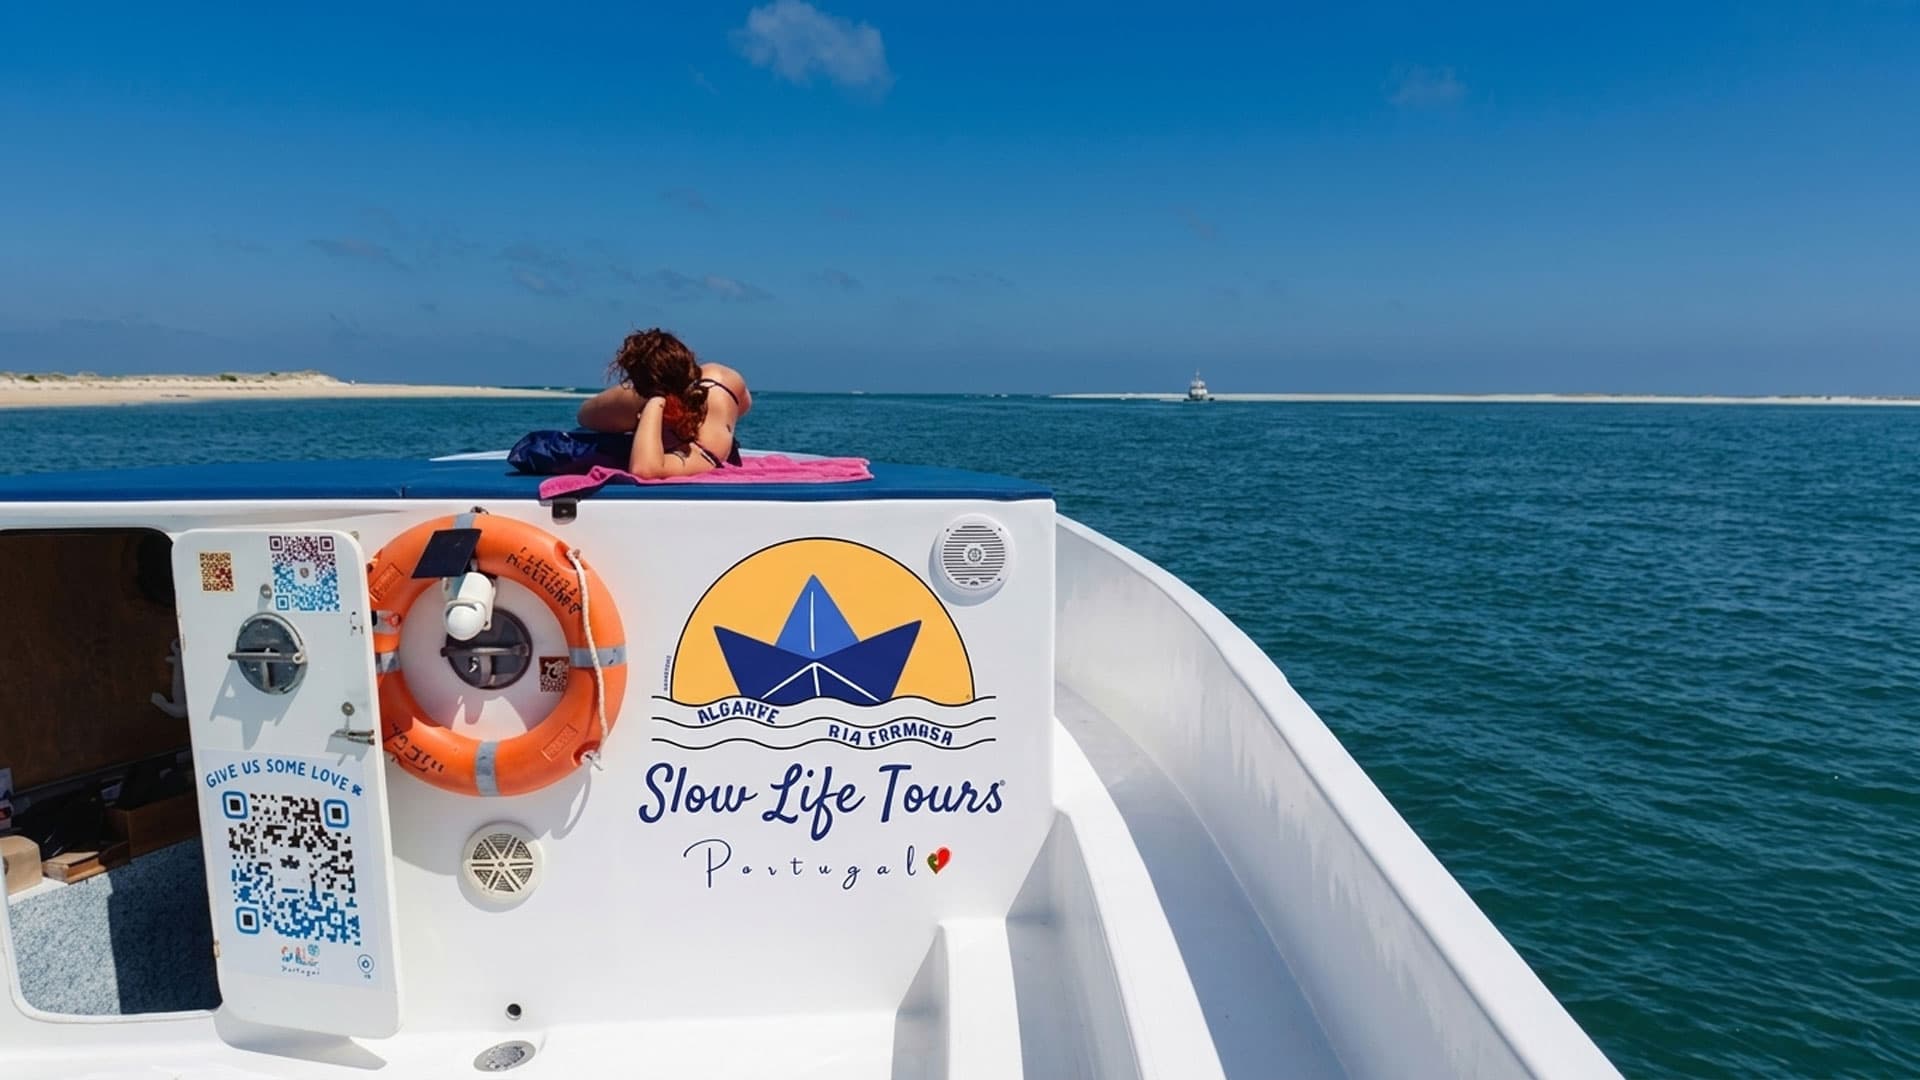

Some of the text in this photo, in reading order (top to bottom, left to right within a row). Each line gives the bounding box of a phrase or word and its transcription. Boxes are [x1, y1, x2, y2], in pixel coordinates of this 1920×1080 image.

[829, 724, 861, 746] RIA
[206, 758, 349, 791] GIVE US SOME LOVE
[639, 763, 758, 823] Slow
[762, 763, 865, 841] Life
[683, 839, 916, 890] Portugal
